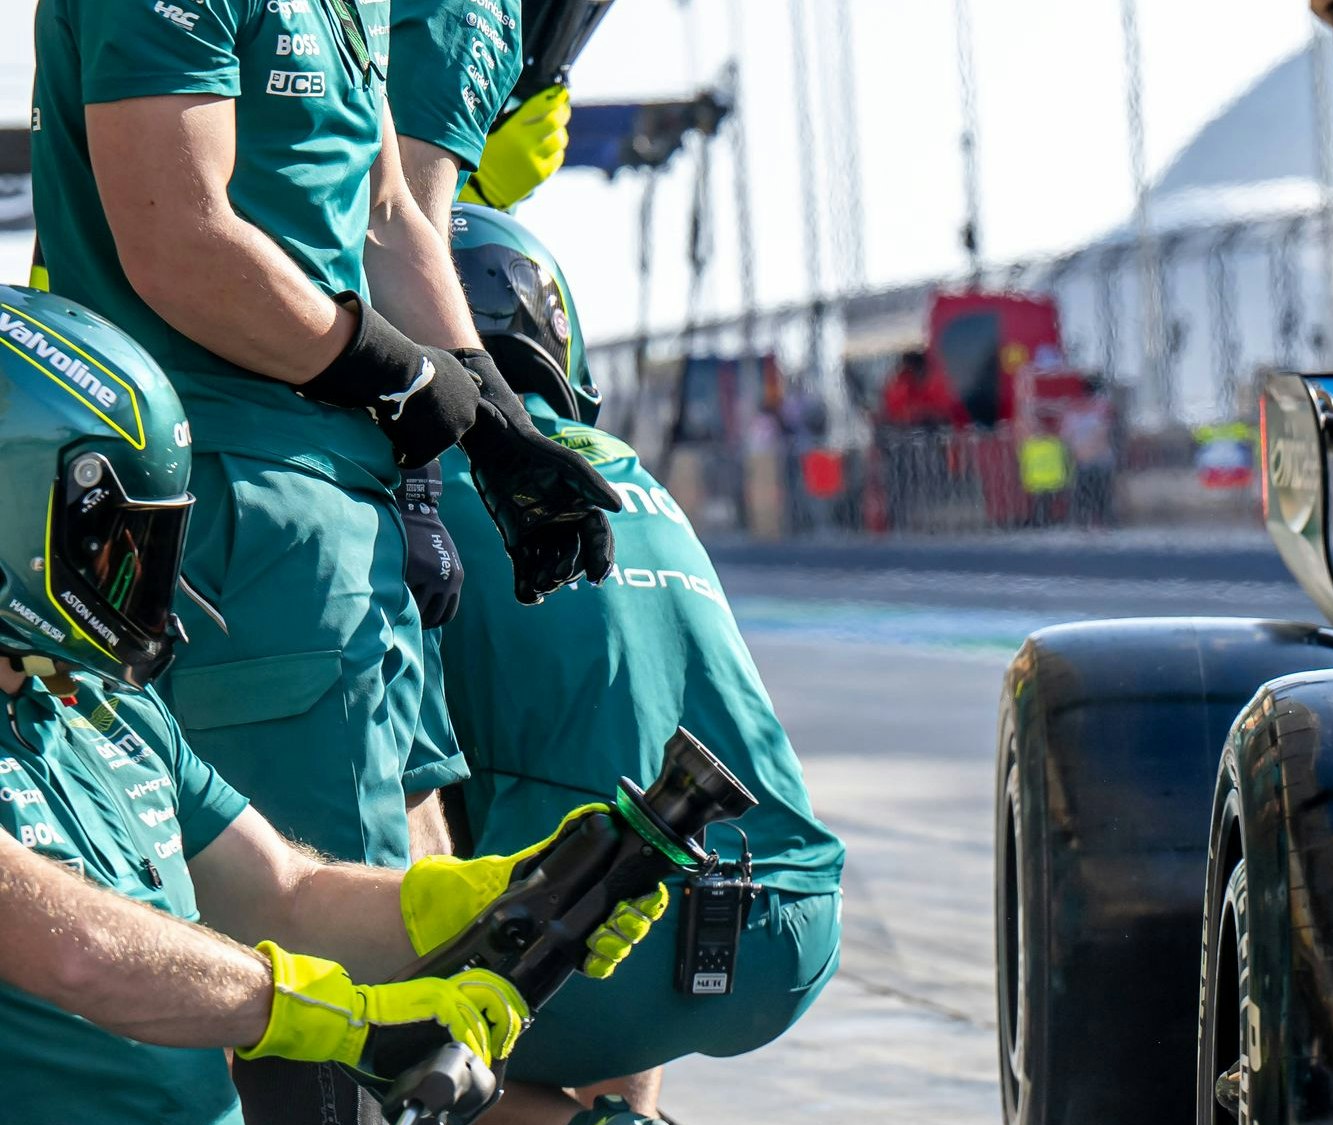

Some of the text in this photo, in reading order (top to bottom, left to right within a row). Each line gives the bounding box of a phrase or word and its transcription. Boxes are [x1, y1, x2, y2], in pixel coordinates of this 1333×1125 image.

[276, 34, 321, 56] BOSS
[270, 71, 325, 96] JCB
[0, 312, 118, 408] Valvoline
[432, 534, 452, 577] HyFlex
[10, 598, 66, 643] HARRY RUSH
[61, 590, 120, 646] ASTON MARTIN
